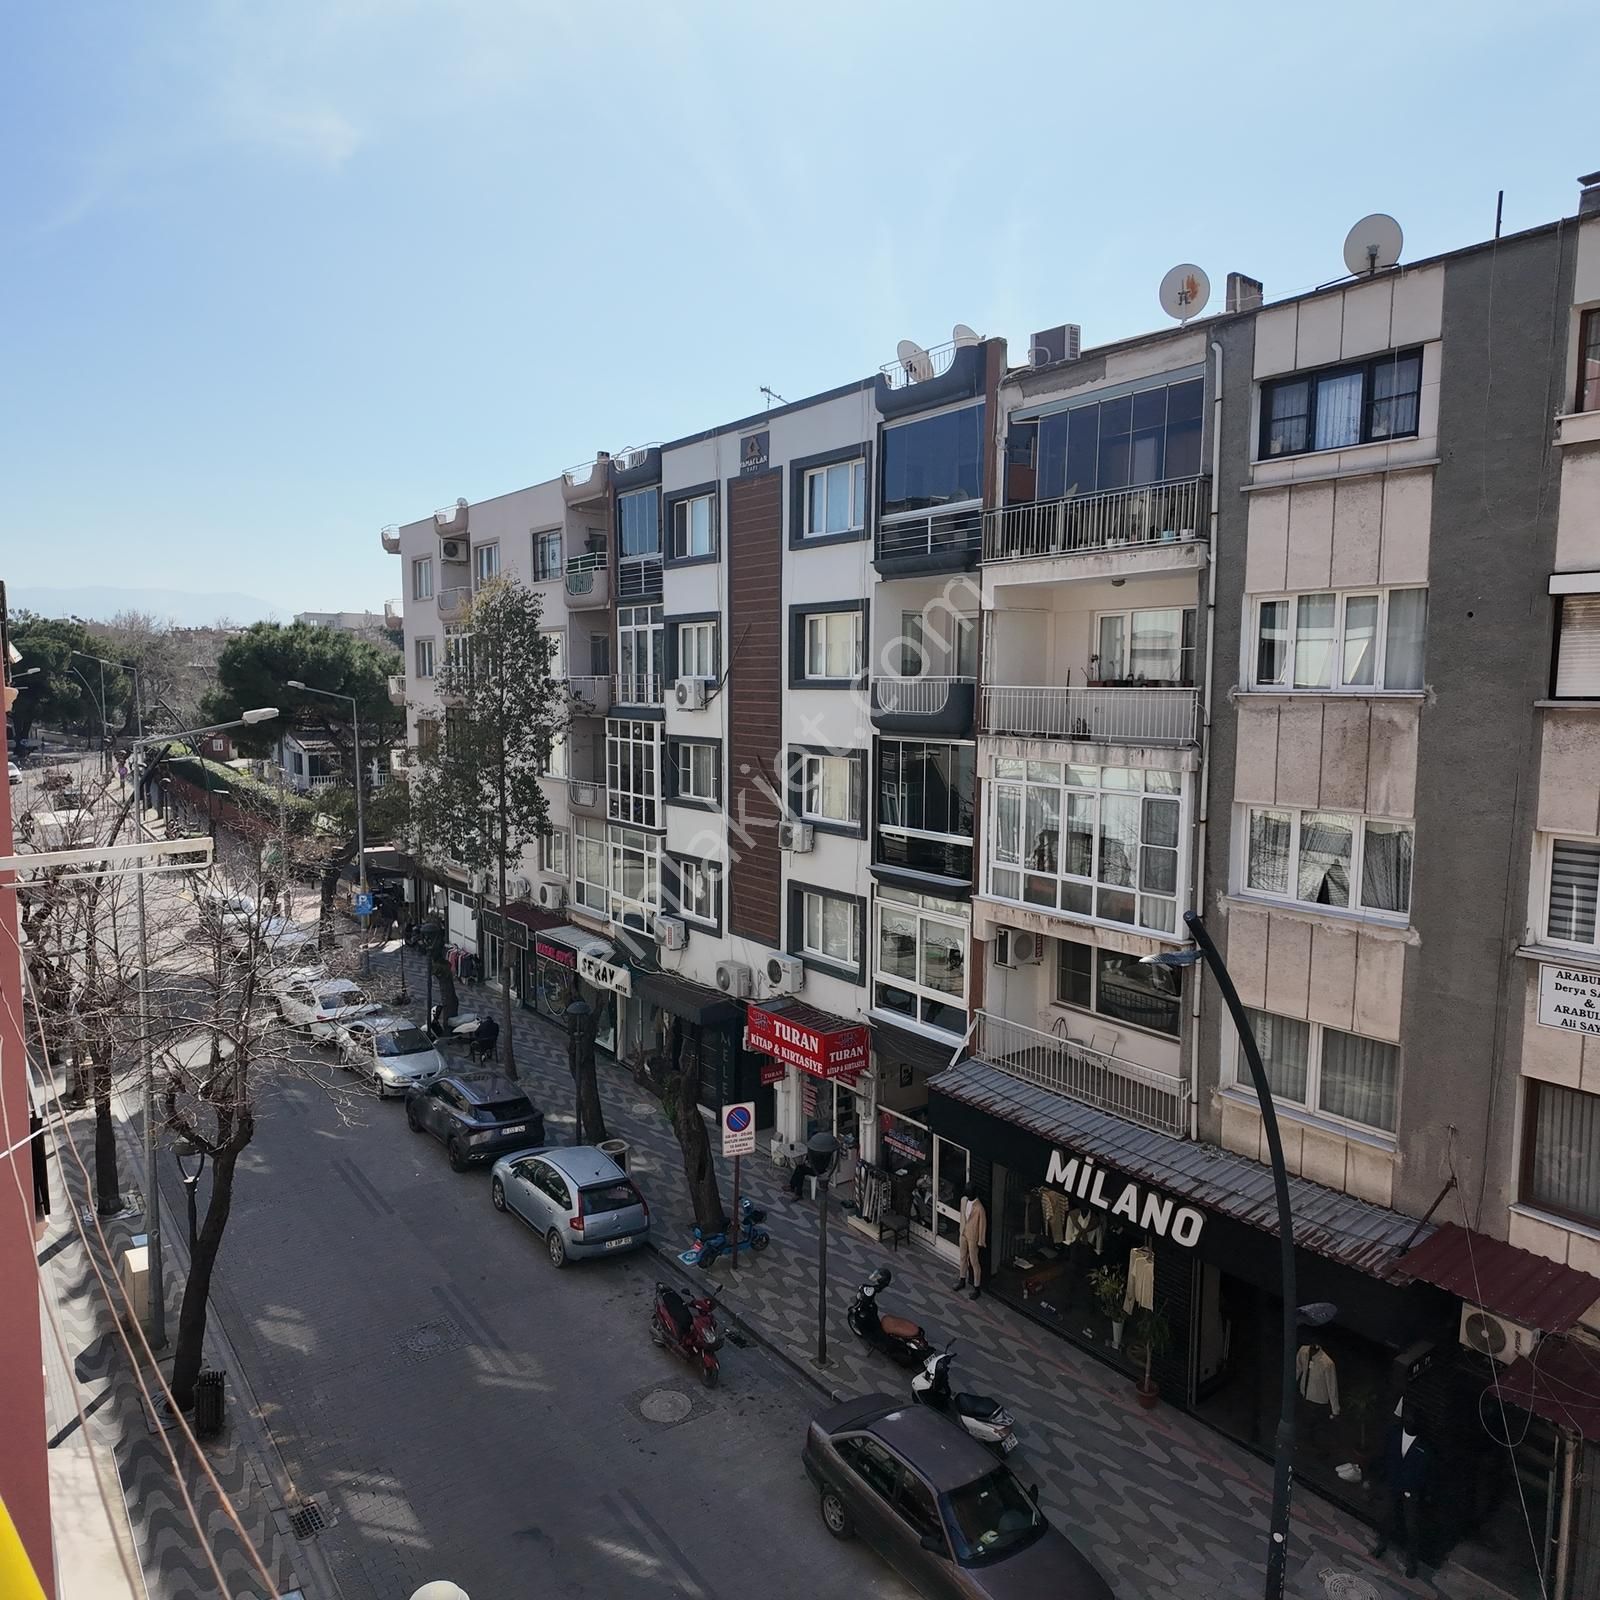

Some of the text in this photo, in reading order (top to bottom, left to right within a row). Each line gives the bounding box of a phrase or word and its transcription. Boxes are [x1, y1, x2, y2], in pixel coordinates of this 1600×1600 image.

[1556, 970, 1600, 985] ARABU
[1554, 982, 1586, 996] Derya
[1583, 998, 1596, 1009] &
[1560, 1018, 1576, 1028] Ali
[773, 1020, 819, 1054] TURAN
[751, 1032, 823, 1075] KİTAP & KIRTASİYE
[829, 1045, 864, 1063] TURAN
[1045, 1149, 1203, 1247] MİLANO
